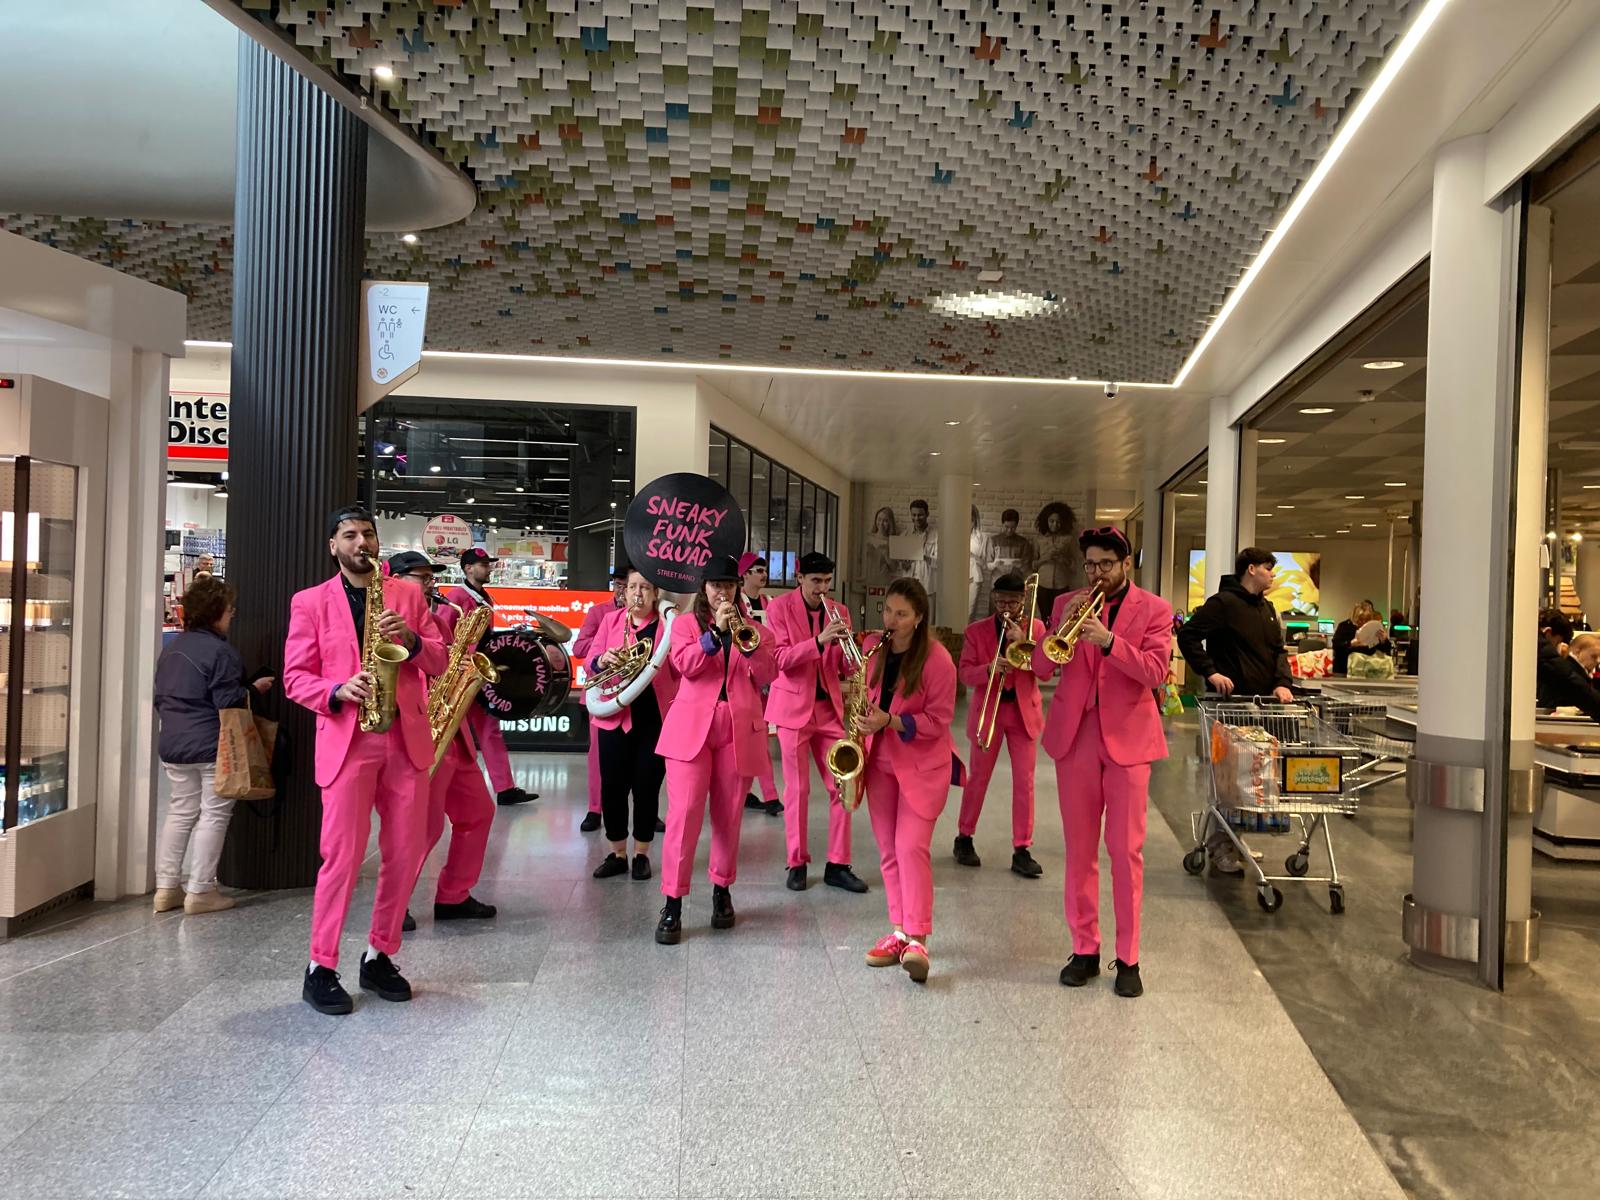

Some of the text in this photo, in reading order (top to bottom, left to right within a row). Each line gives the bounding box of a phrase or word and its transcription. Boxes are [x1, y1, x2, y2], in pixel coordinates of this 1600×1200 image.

[378, 304, 398, 315] WC
[646, 495, 729, 528] SNEAKY
[447, 537, 459, 545] LG
[653, 519, 714, 548] FUNK
[646, 538, 713, 568] SQUAD
[656, 568, 696, 581] STREET BAND
[538, 605, 570, 613] mobiles
[489, 635, 536, 653] SNEAKY
[533, 656, 547, 695] FUNK
[481, 683, 513, 712] SQUAD
[499, 716, 570, 732] MSUNG
